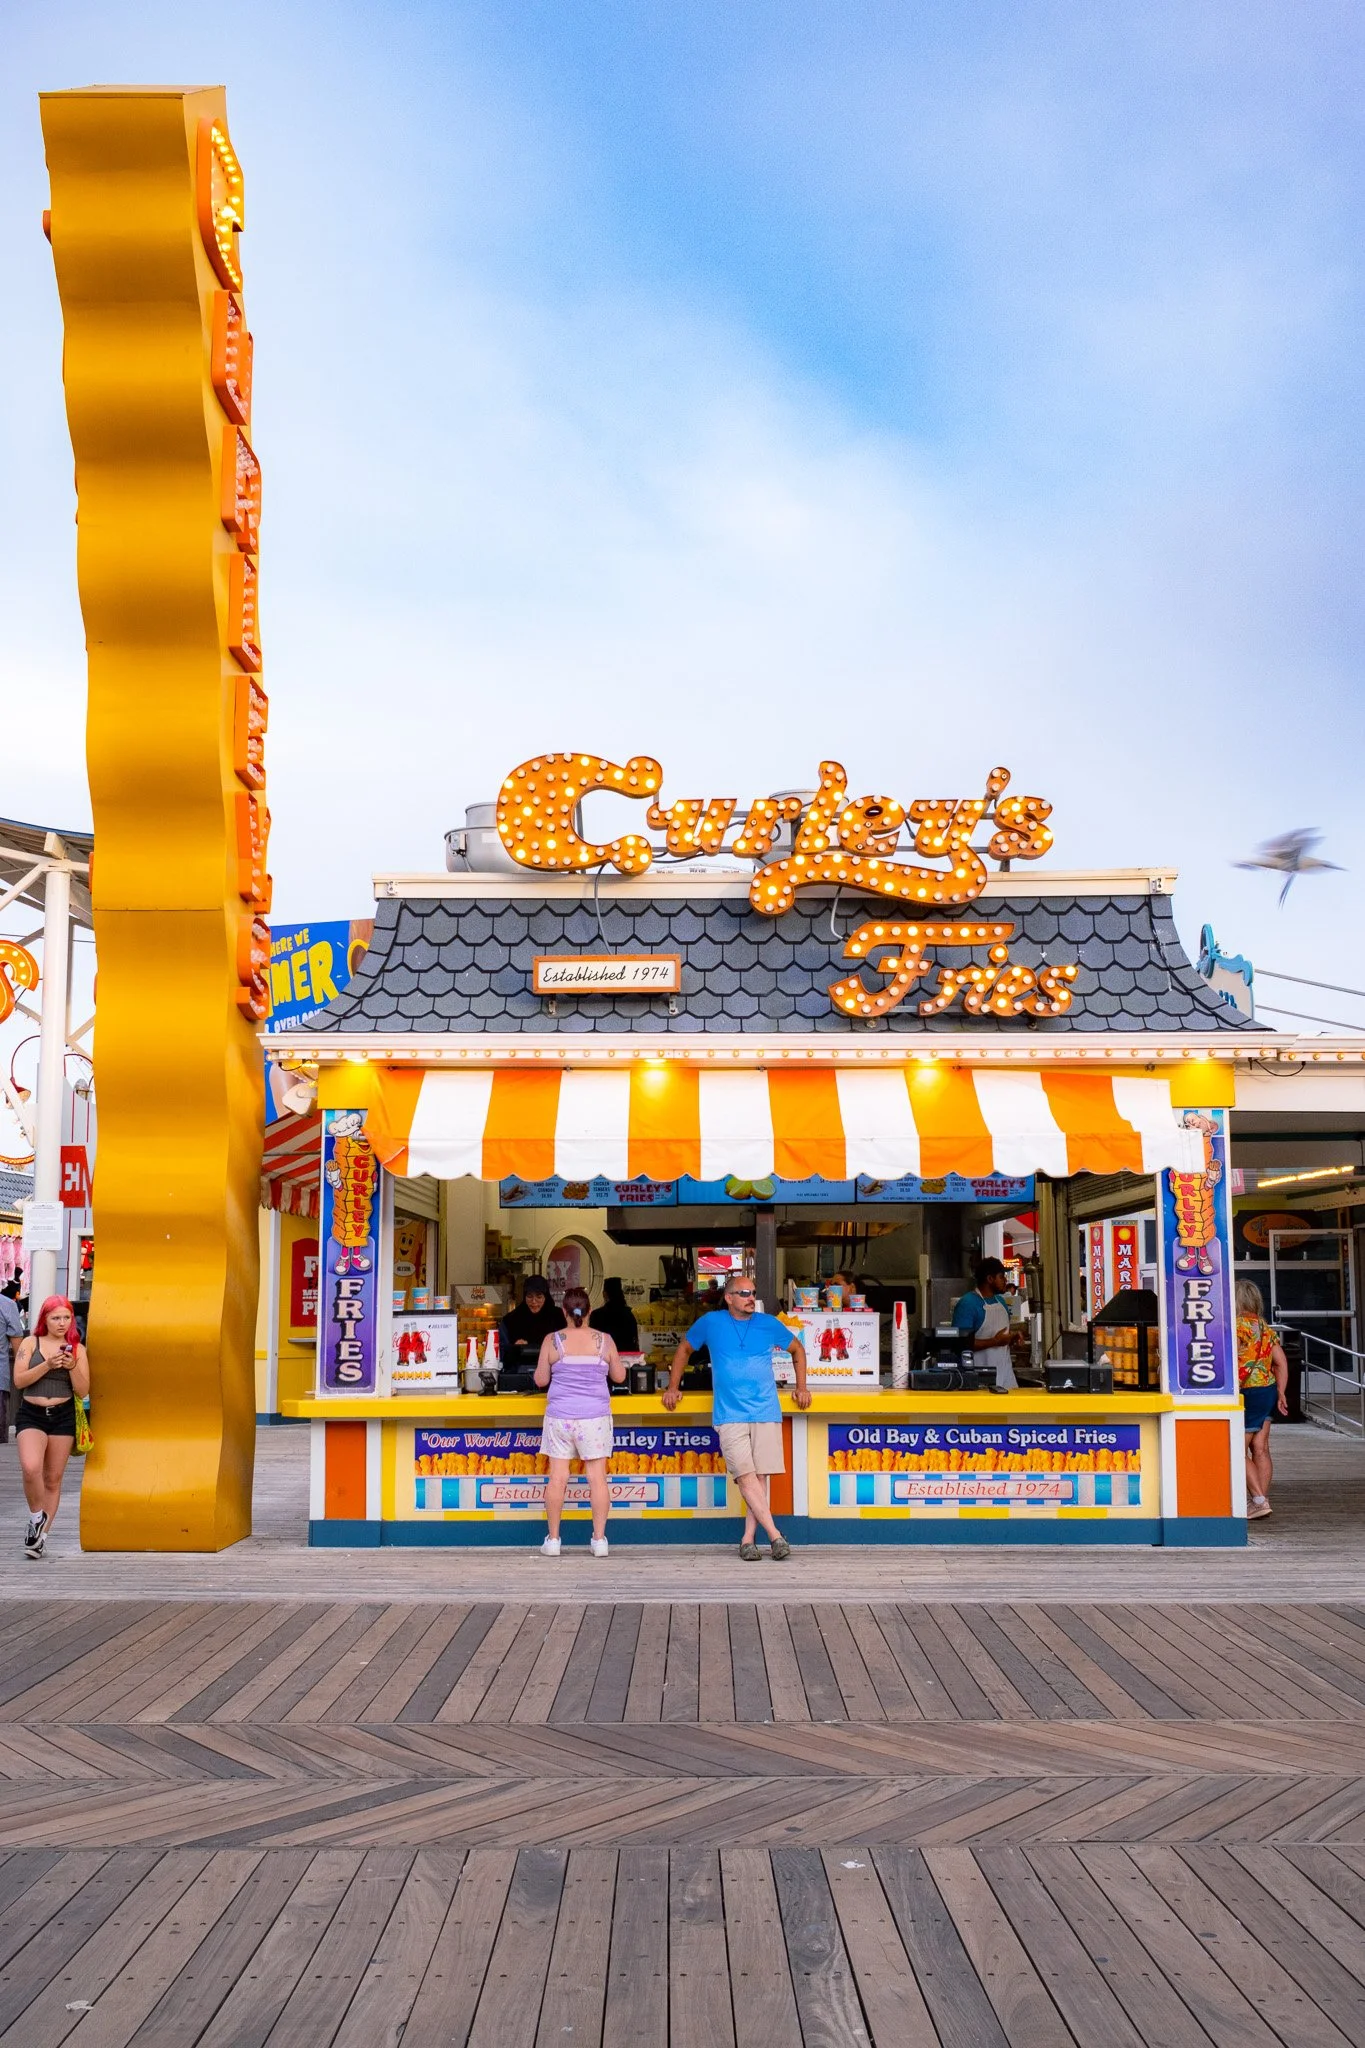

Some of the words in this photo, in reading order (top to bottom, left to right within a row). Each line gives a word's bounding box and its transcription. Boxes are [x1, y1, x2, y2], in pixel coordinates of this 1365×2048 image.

[496, 752, 1053, 916] Curley's
[294, 927, 310, 946] WE
[261, 941, 340, 1013] MER
[543, 965, 626, 983] Established
[632, 966, 669, 981] 1974
[828, 921, 1079, 1018] Fries
[615, 1184, 672, 1193] CURLEY'S
[970, 1179, 1026, 1188] CURLEY'S
[974, 1189, 1009, 1197] FRIES
[352, 1154, 369, 1238] CURLEY
[619, 1194, 655, 1202] FRIES
[1178, 1172, 1196, 1238] URLEY
[1093, 1245, 1103, 1316] MARGA
[335, 1278, 365, 1383] FRIES
[1184, 1279, 1216, 1383] FRIES
[421, 1432, 460, 1448] "Our
[464, 1431, 511, 1448] World
[613, 1430, 657, 1450] urley
[663, 1431, 711, 1446] Fries
[848, 1429, 881, 1444] Old
[886, 1429, 919, 1447] Bay
[924, 1429, 940, 1444] &
[945, 1429, 1003, 1444] Cuban
[1008, 1428, 1068, 1447] Spiced
[1074, 1428, 1117, 1444] Fries
[494, 1485, 591, 1499] Establhed
[611, 1485, 646, 1499] 974
[907, 1482, 1006, 1496] Established
[1015, 1483, 1061, 1496] 1974
